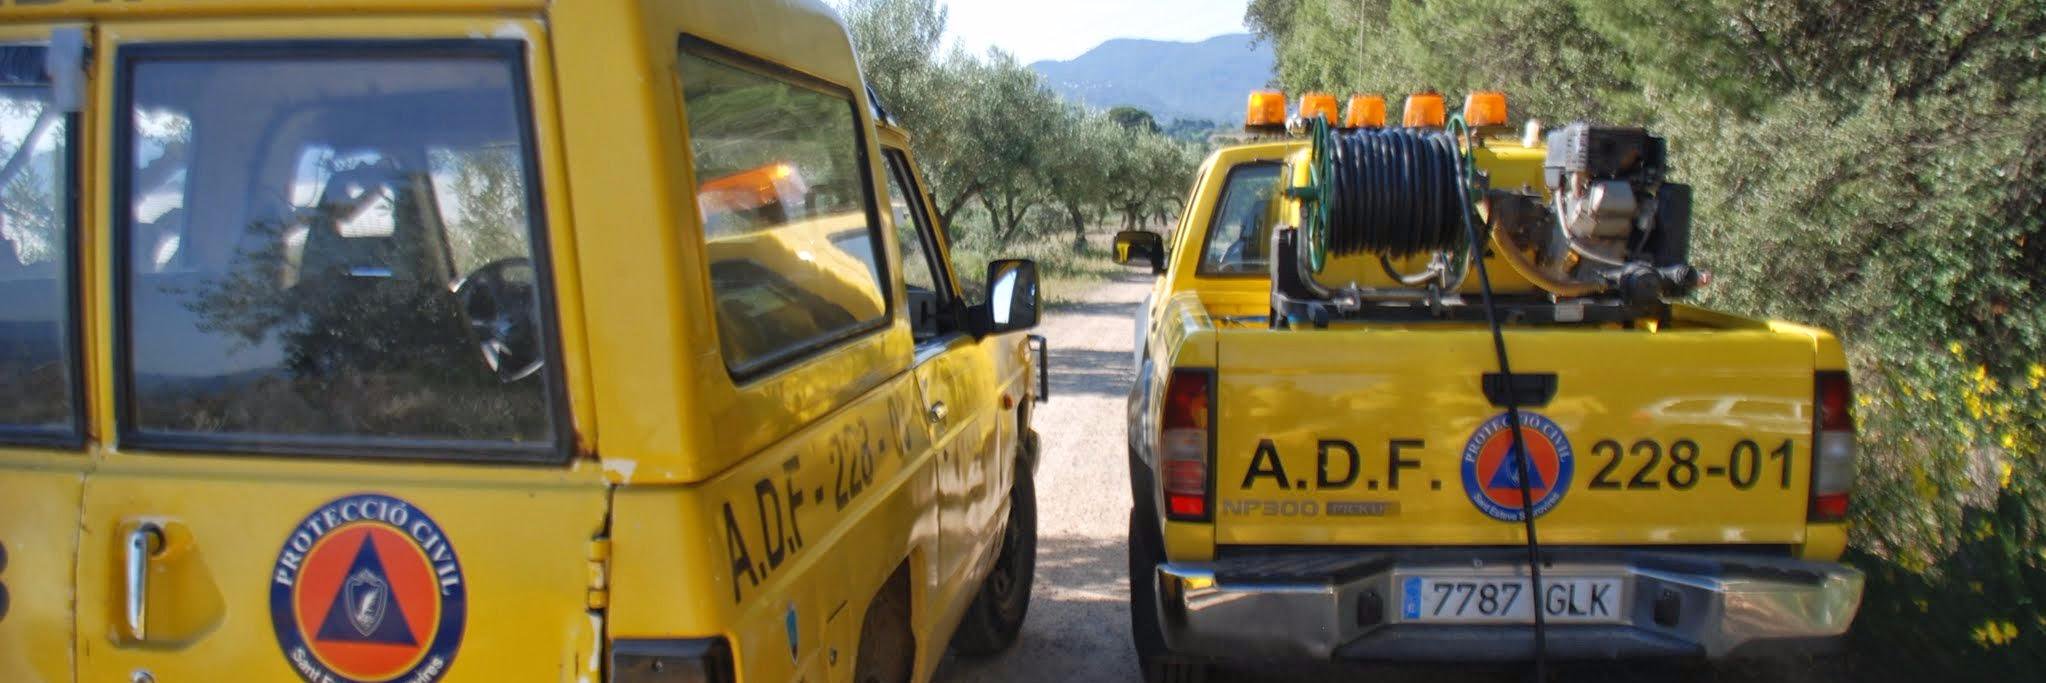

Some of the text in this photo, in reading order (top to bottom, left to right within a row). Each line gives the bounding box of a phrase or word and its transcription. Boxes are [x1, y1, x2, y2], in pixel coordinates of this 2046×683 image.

[829, 416, 873, 512] 228
[1465, 413, 1571, 464] PROTECIÓ CIVIL
[1240, 438, 1441, 491] A.D.F.
[1588, 439, 1794, 490] 228-01
[1224, 500, 1320, 515] NP300
[276, 499, 460, 596] PROTECCIÓ CIVIL
[1433, 583, 1522, 617] 7787
[1546, 584, 1611, 616] GLK
